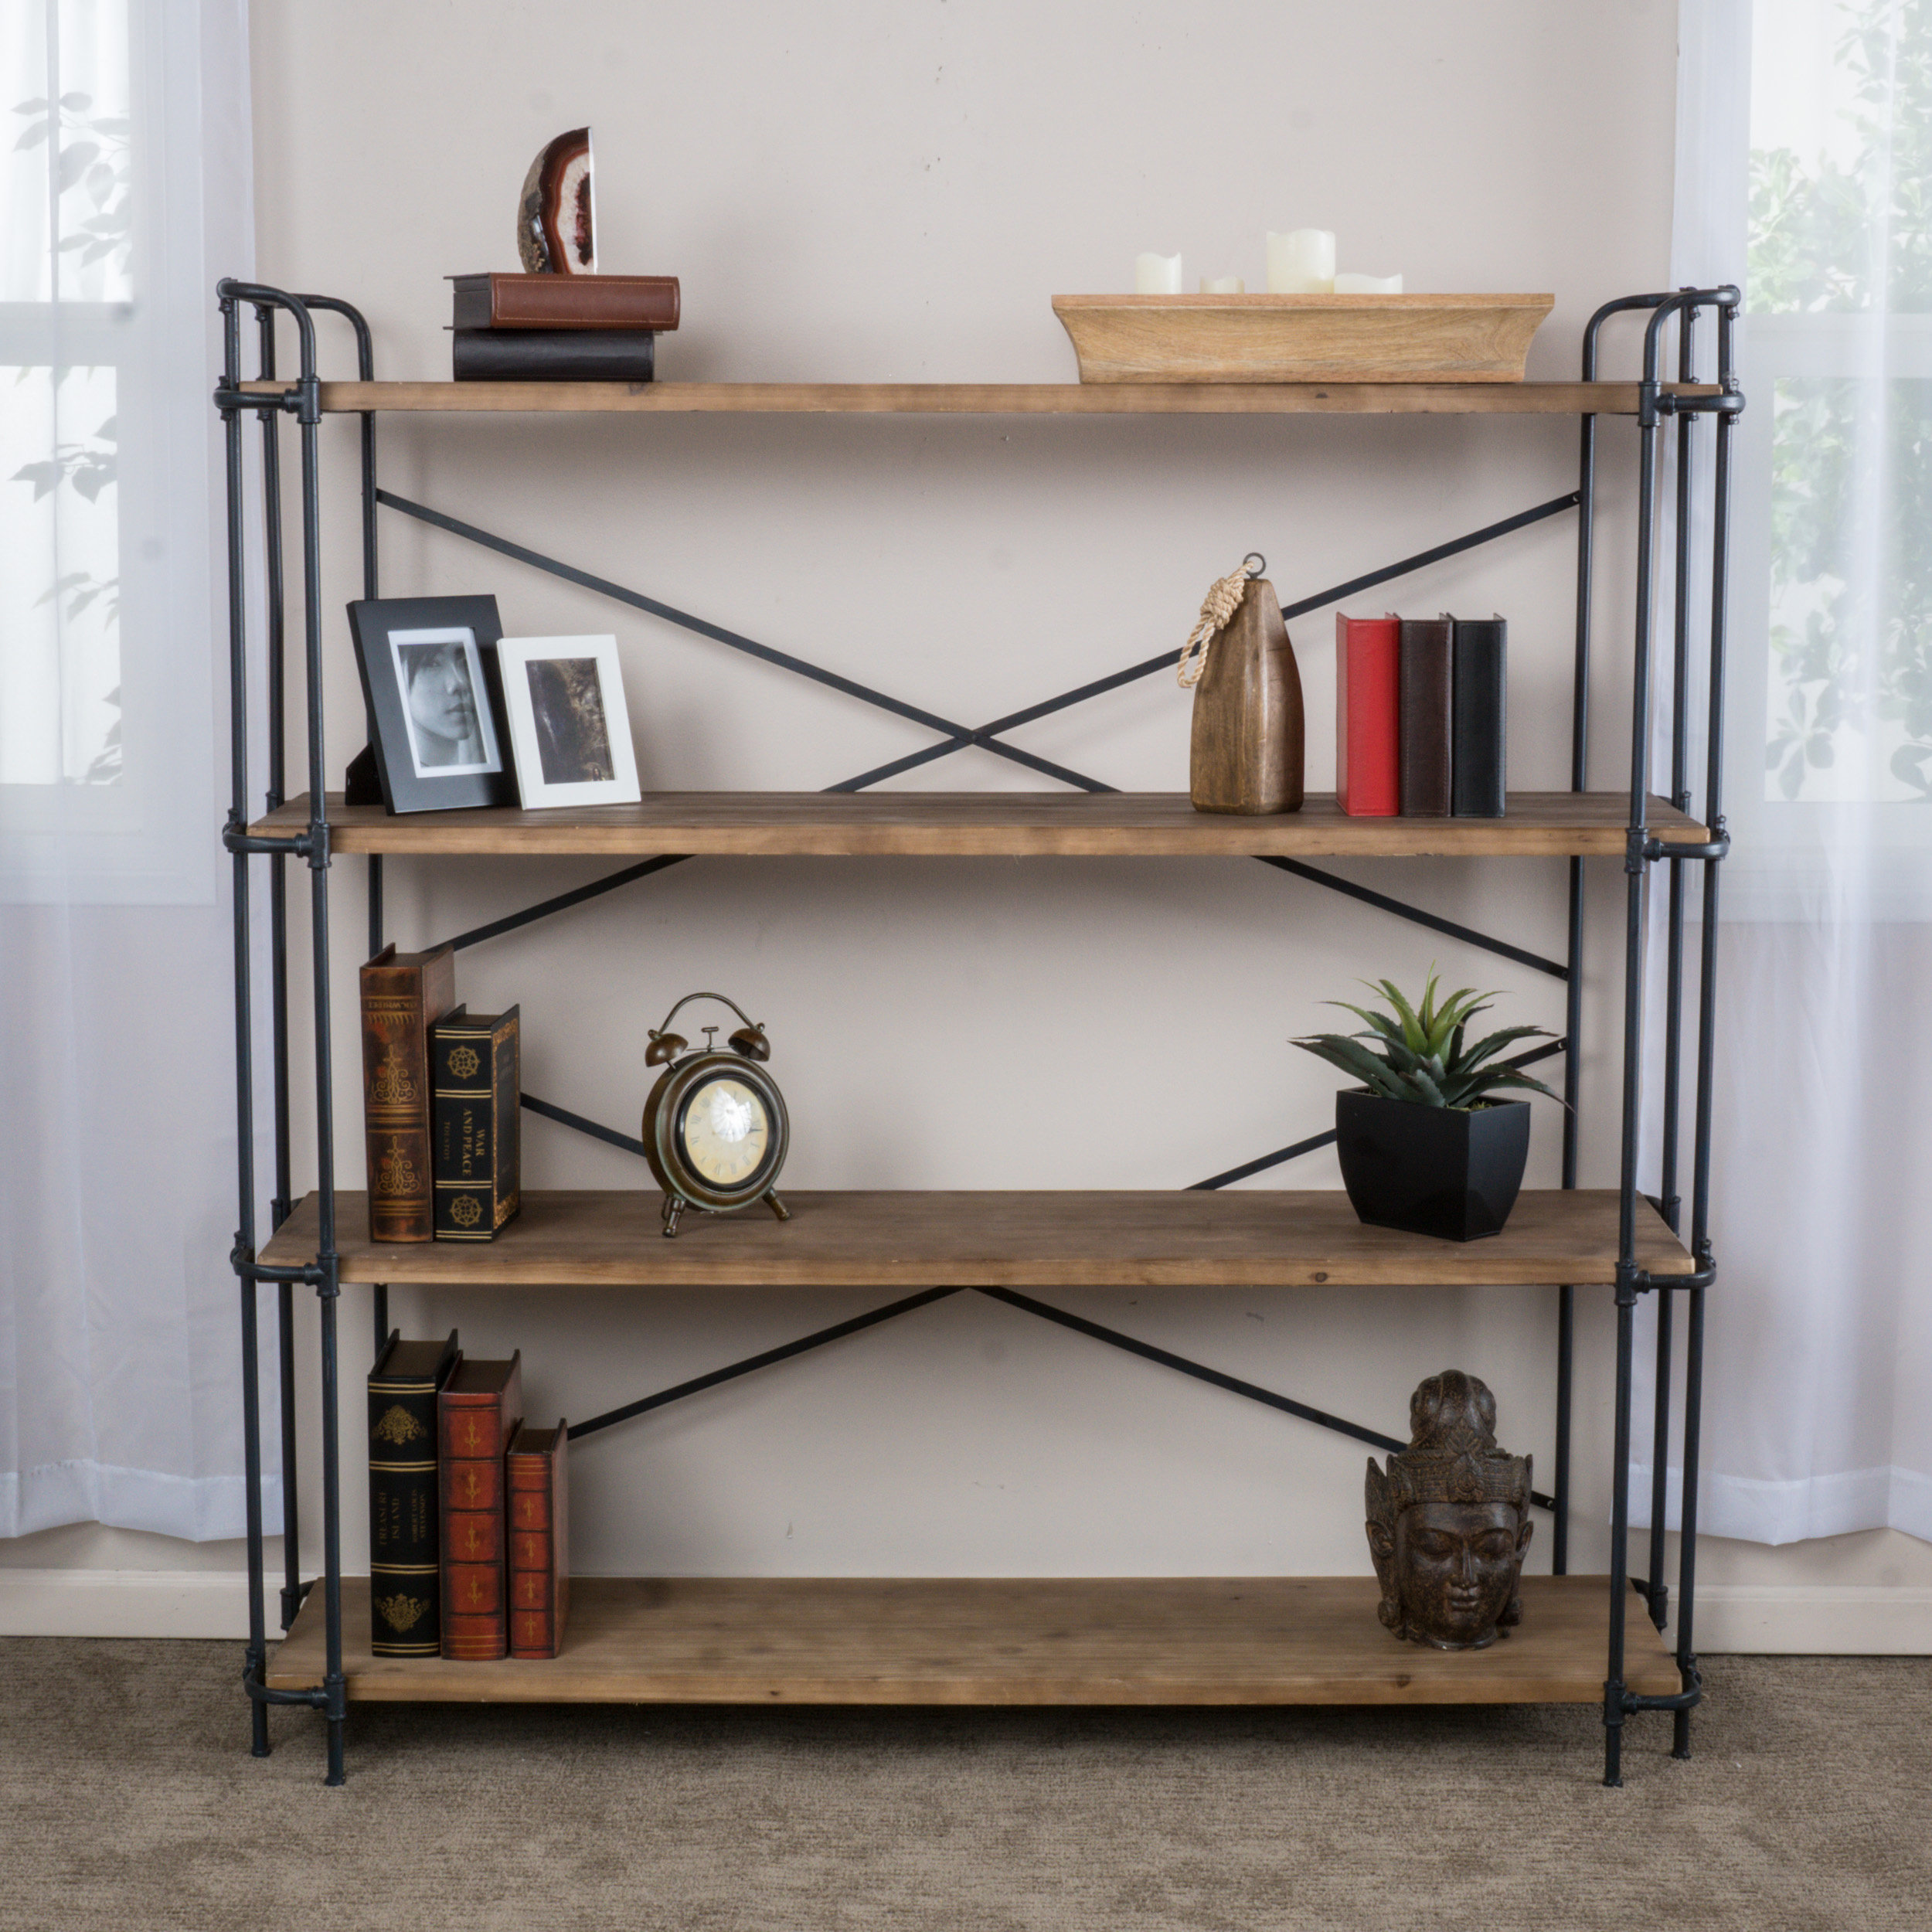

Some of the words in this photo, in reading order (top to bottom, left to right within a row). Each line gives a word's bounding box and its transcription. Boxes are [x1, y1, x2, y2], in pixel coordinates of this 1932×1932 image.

[463, 1107, 473, 1134] AND
[462, 1136, 473, 1176] PEACE
[475, 1128, 486, 1157] WAR
[391, 1498, 400, 1539] ISLAND
